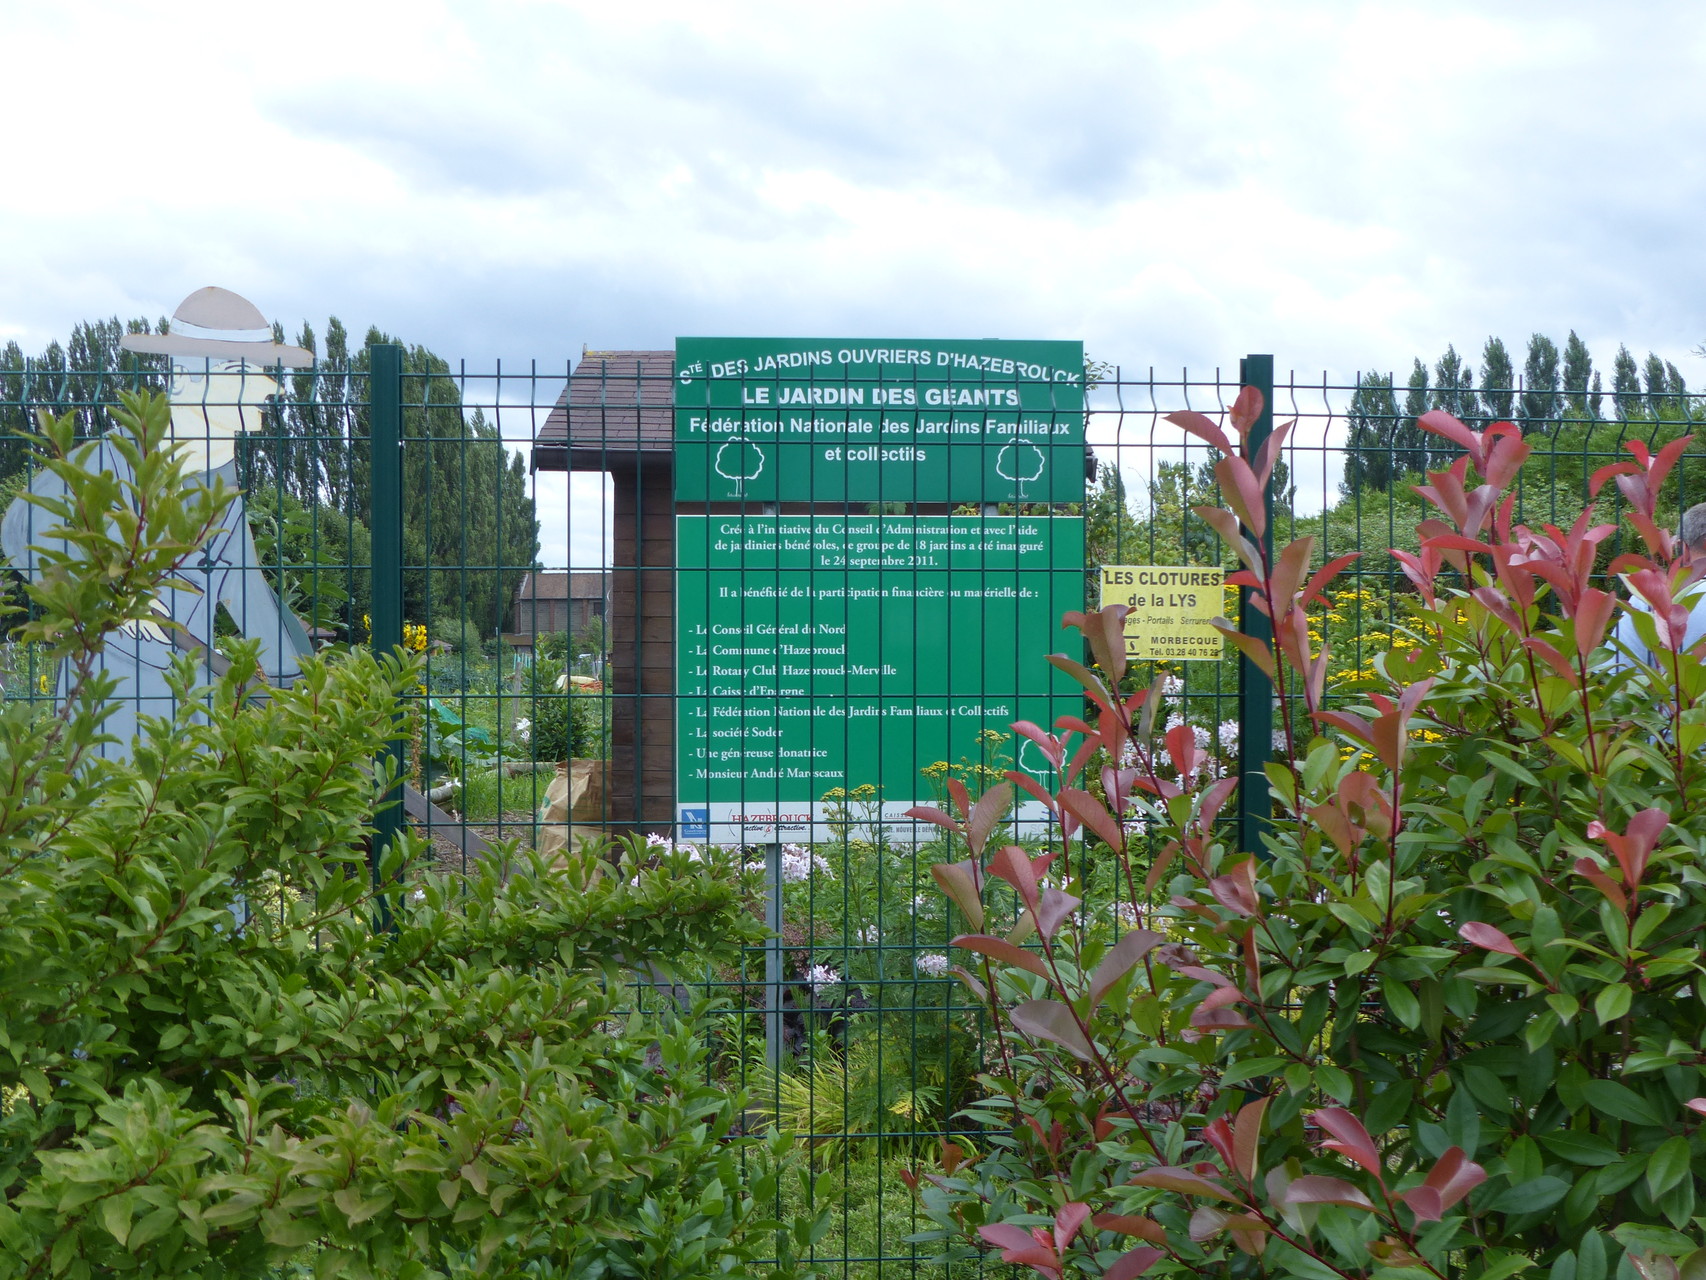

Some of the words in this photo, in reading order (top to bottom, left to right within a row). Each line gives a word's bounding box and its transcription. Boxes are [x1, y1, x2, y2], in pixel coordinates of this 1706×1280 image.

[711, 360, 749, 378] DES
[754, 351, 832, 371] JARDINS
[838, 349, 931, 365] OUVRIERS
[937, 352, 1080, 388] D'HAZEBROUCK
[742, 387, 769, 404] LE
[779, 387, 864, 404] JARDIN
[872, 388, 917, 405] DES
[690, 417, 784, 433] Fédération
[790, 418, 873, 433] Nationale
[879, 419, 910, 434] des
[915, 419, 980, 434] Jardins
[986, 419, 1070, 435] Familiaux
[824, 447, 842, 461] et
[847, 446, 926, 461] collectifs
[748, 524, 755, 535] à
[757, 523, 812, 535] l'intiative
[815, 523, 830, 534] du
[832, 523, 873, 535] Conseil
[970, 526, 981, 535] et
[983, 527, 1006, 535] avec
[714, 539, 728, 550] de
[730, 539, 782, 553] jadiniers
[784, 539, 840, 552] bénéoles,
[856, 542, 895, 554] groupe
[897, 539, 910, 550] de
[968, 543, 975, 551] a
[977, 540, 994, 551] été
[821, 554, 831, 565] le
[833, 555, 846, 566] 24
[849, 554, 905, 569] septembre
[907, 555, 938, 566] 2011.
[1105, 571, 1133, 585] LES
[1138, 572, 1220, 586] CLOTURES
[719, 586, 728, 598] Il
[731, 589, 737, 598] a
[790, 586, 804, 597] de
[819, 586, 889, 601] partiipation
[1019, 586, 1032, 598] de
[1128, 594, 1146, 606] de
[1151, 594, 1164, 606] la
[1169, 594, 1196, 607] LYS
[1147, 616, 1174, 625] Portails
[712, 623, 753, 635] Consil
[818, 623, 846, 635] Nord
[1150, 636, 1219, 646] MORBECQUE
[712, 644, 770, 655] Commune
[1149, 647, 1163, 656] Tél.
[1187, 648, 1197, 656] 40
[712, 665, 750, 679] Rotary
[752, 664, 778, 676] Club
[782, 664, 897, 676] Hazerouck-Mervlle
[712, 685, 747, 696] Caiss
[712, 706, 771, 717] Fédération
[828, 705, 846, 716] des
[890, 705, 943, 716] Famliaux
[958, 705, 1009, 716] Collctifs
[712, 726, 750, 738] société
[751, 726, 783, 738] Soder
[696, 768, 748, 779] Monsieur
[750, 767, 784, 779] André
[786, 767, 844, 778] Marscaux
